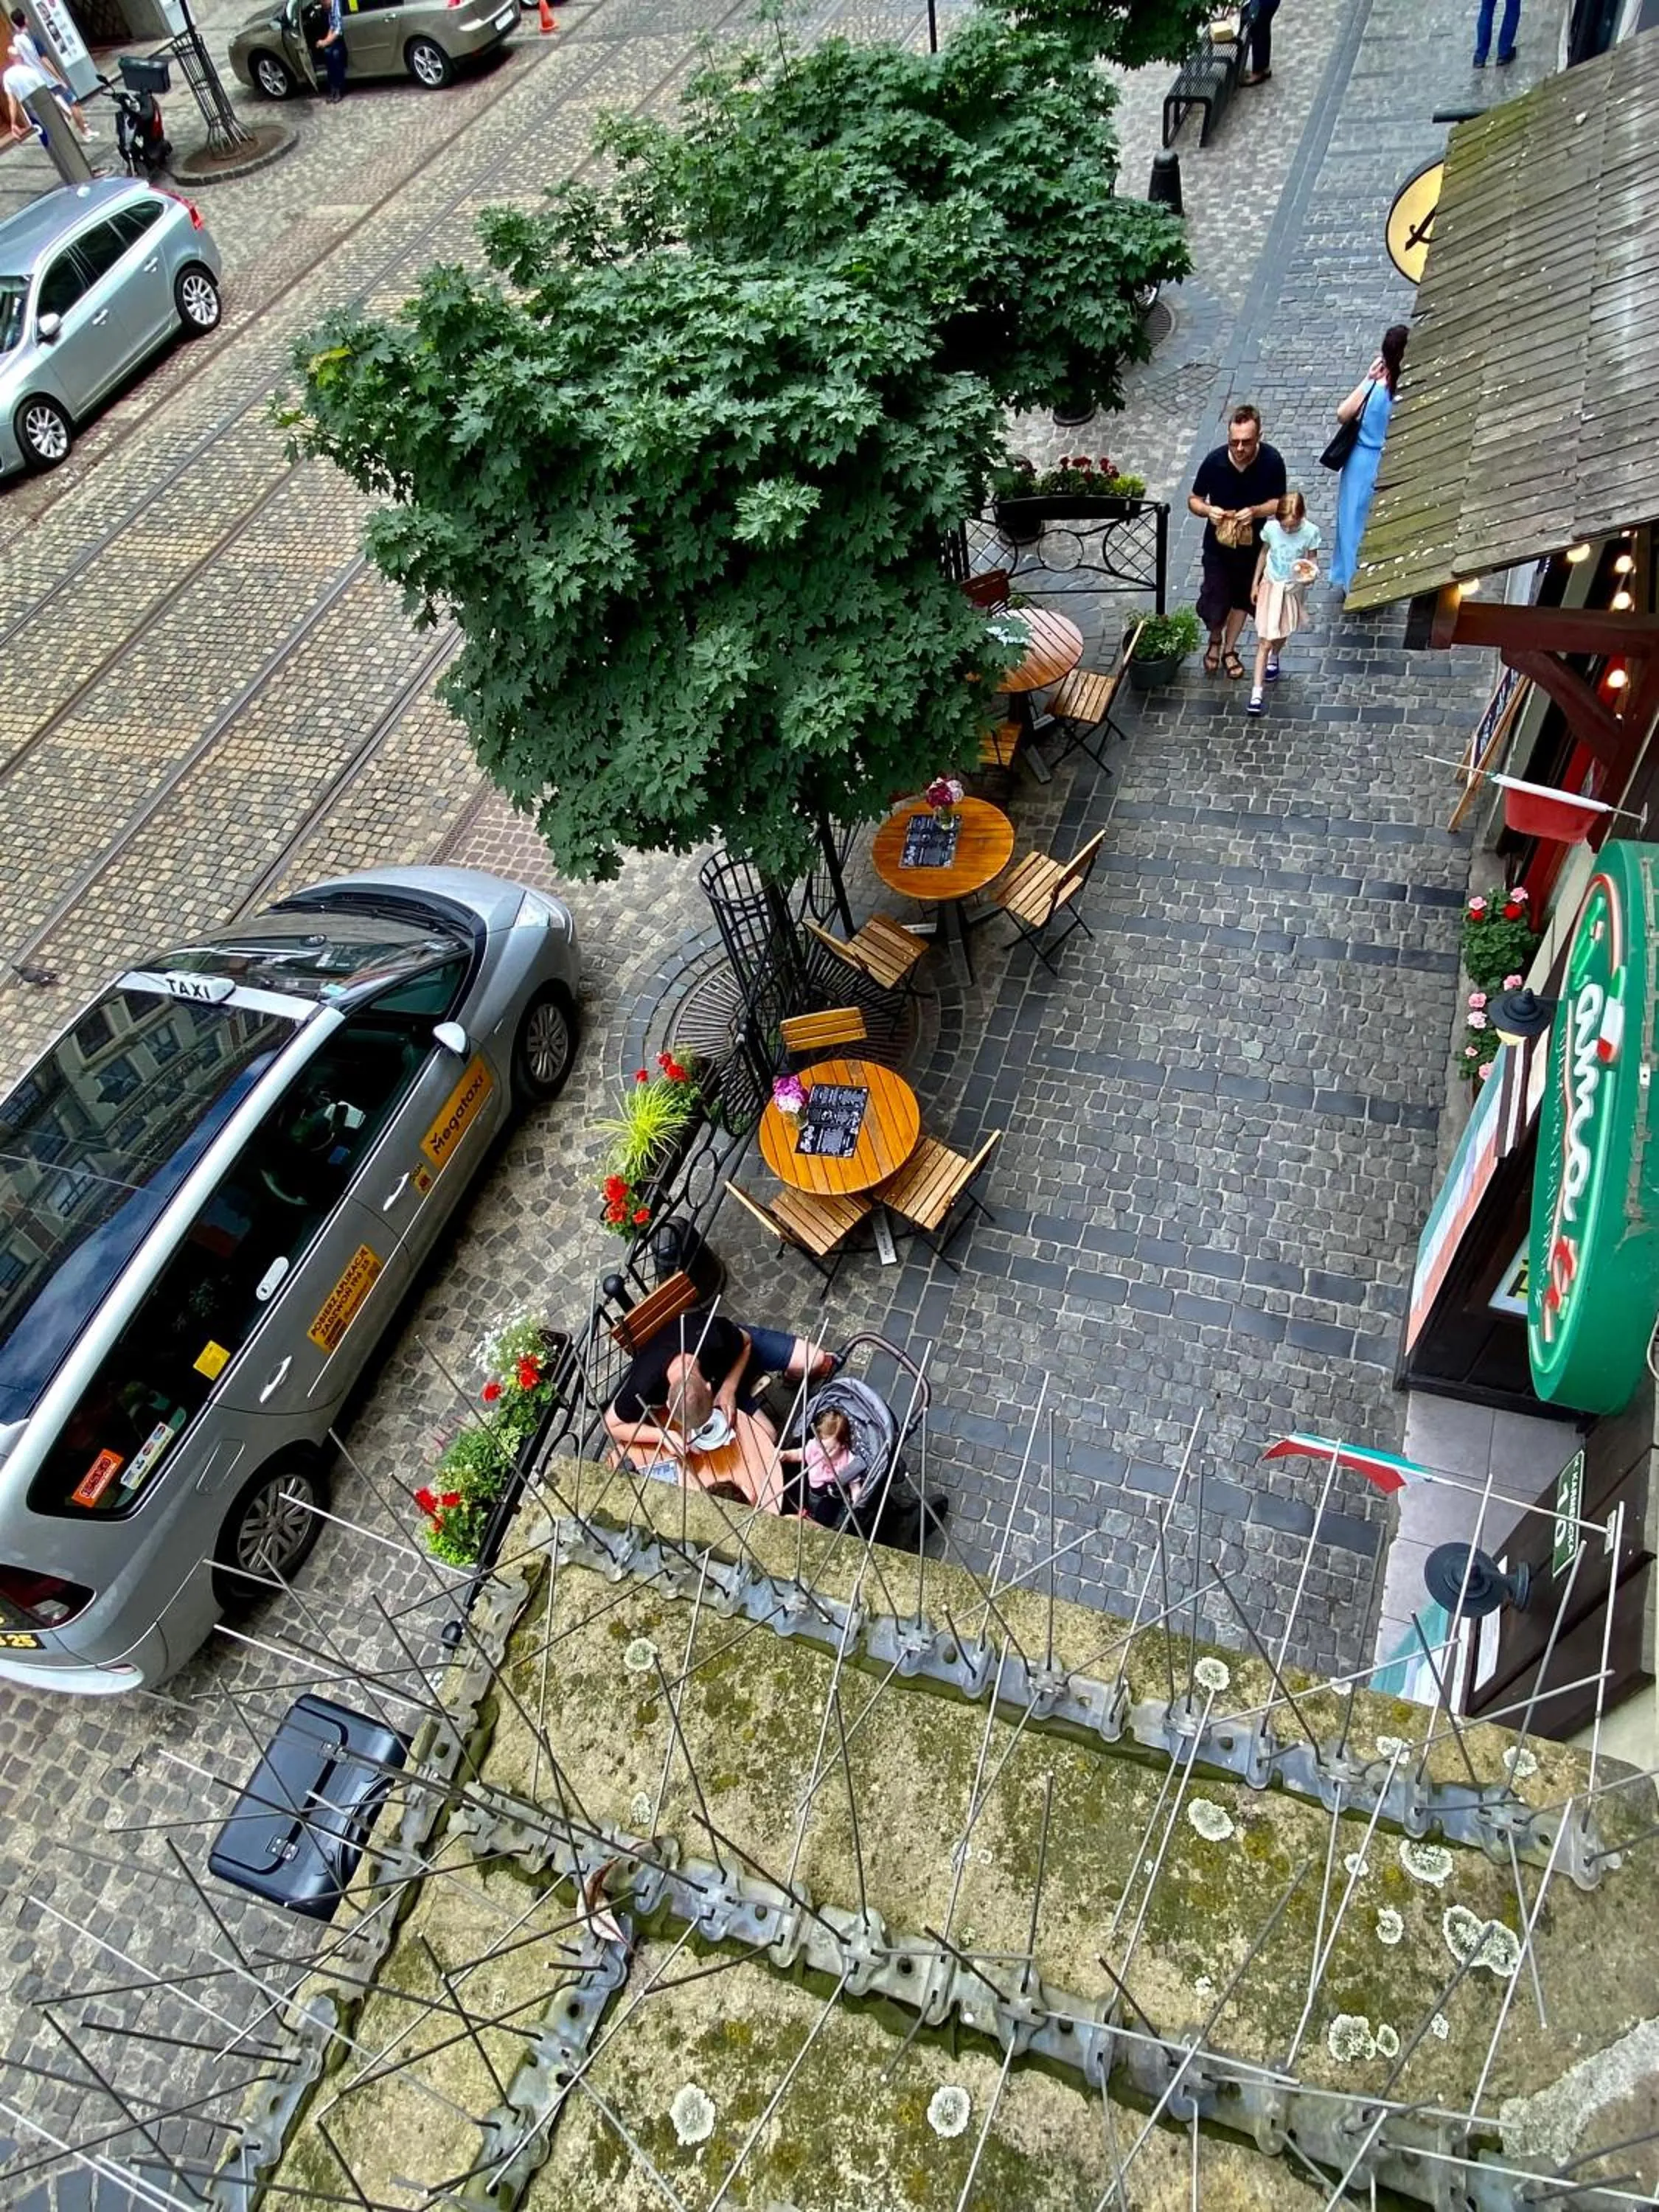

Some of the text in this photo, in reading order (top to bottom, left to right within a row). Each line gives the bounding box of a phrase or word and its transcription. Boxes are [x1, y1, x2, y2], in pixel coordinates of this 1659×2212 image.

[165, 978, 211, 1000] TAXI
[431, 1074, 484, 1155] Megataxi
[7, 1634, 37, 1647] 25
